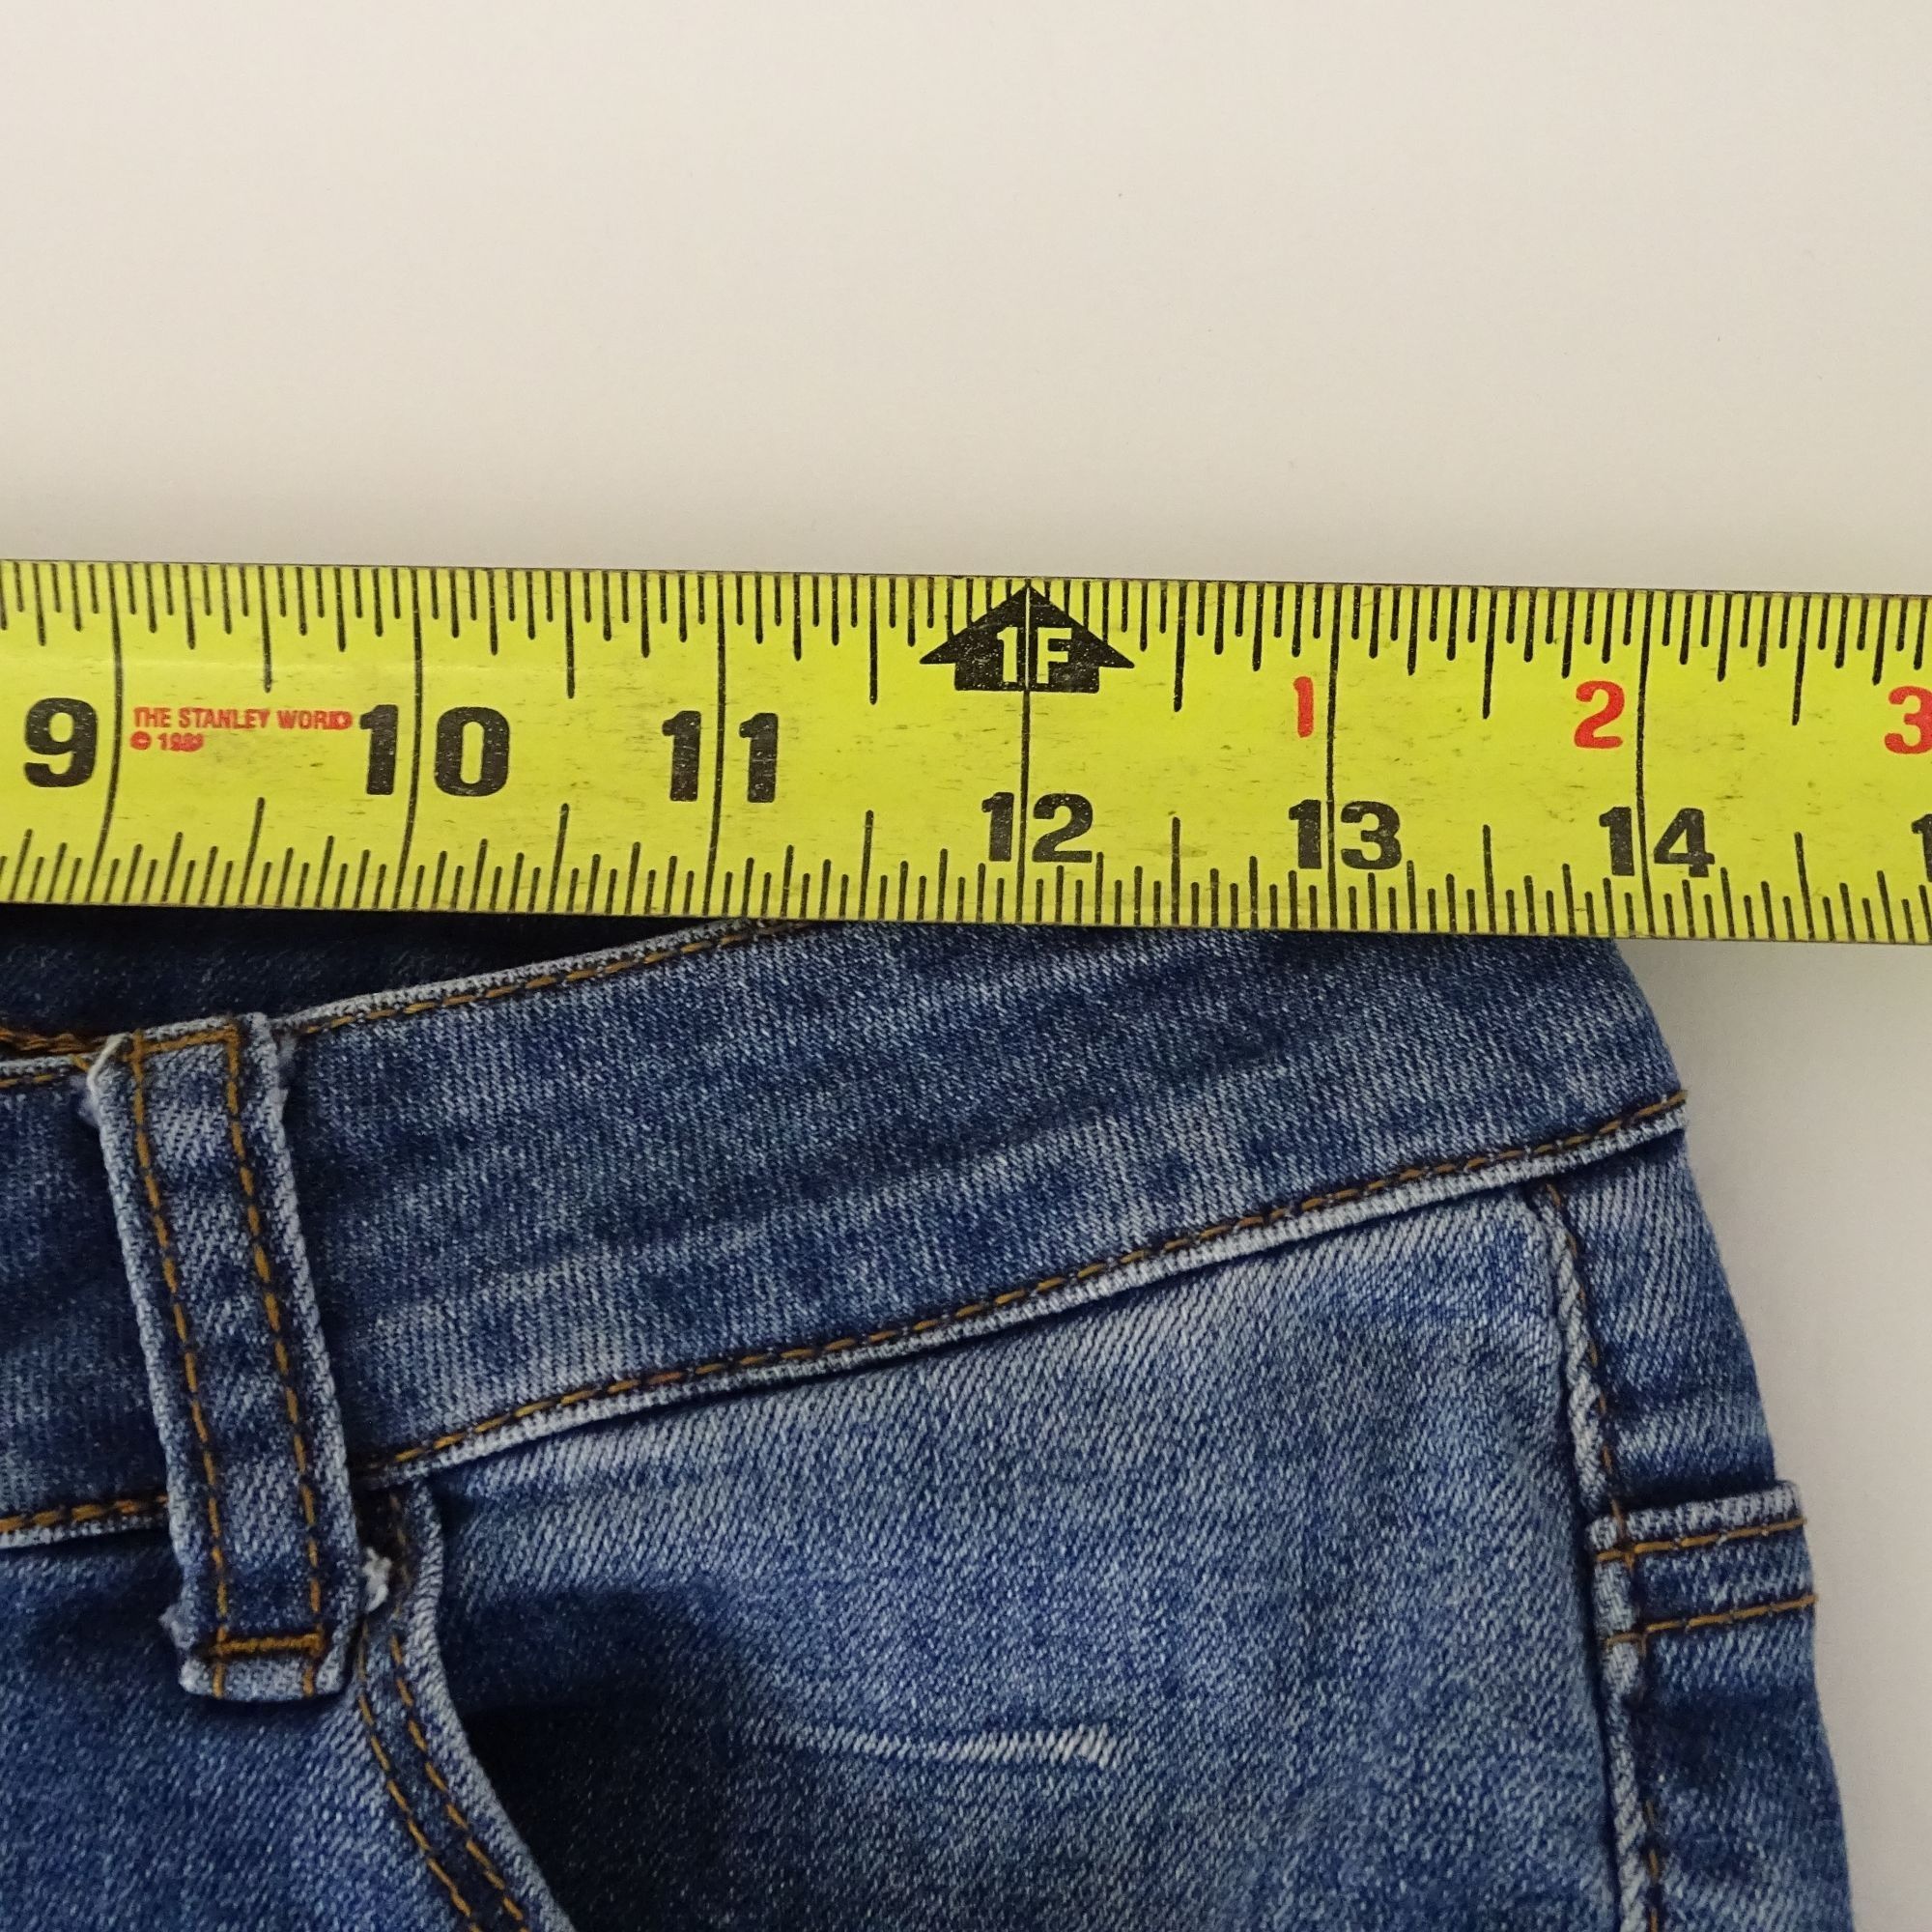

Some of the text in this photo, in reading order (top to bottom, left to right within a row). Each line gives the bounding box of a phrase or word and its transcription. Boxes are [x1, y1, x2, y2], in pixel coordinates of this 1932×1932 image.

[996, 626, 1071, 684] 1F
[24, 697, 99, 787] 9
[133, 707, 171, 727] THE
[178, 707, 271, 730] STANLEY
[1293, 675, 1315, 738] 1
[1573, 680, 1626, 750] 2
[1884, 685, 1932, 754] 3
[359, 704, 510, 797] 10
[662, 710, 779, 804] 11
[981, 791, 1094, 864] 12
[1288, 799, 1403, 870] 13
[1599, 806, 1716, 878] 14
